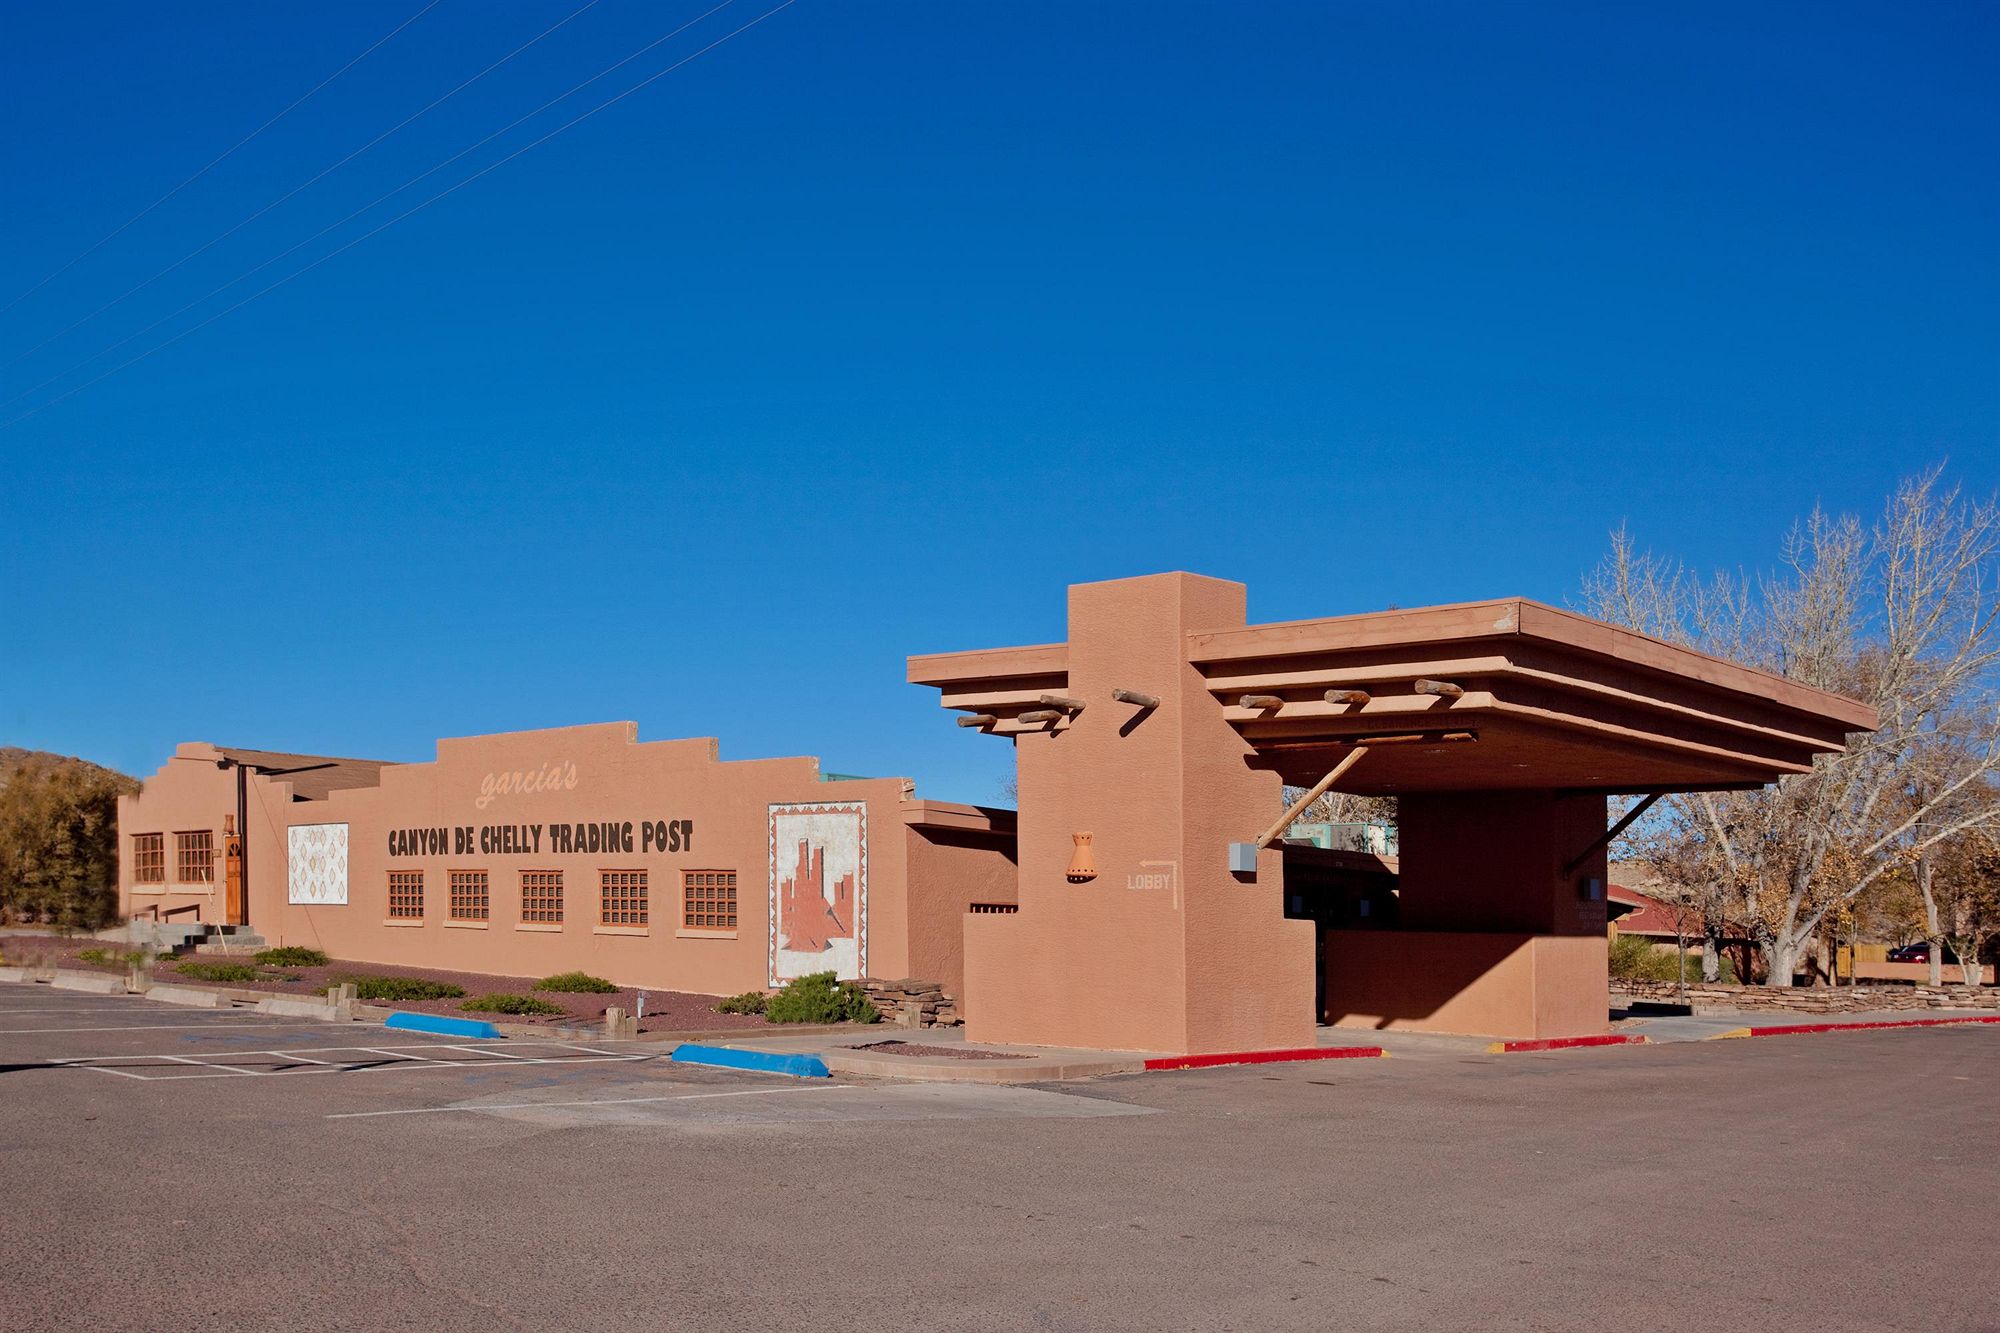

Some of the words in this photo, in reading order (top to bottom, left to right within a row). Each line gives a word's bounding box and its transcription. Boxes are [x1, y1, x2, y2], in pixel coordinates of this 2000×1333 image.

[388, 827, 449, 857] CANYON
[454, 826, 475, 855] DE
[480, 824, 542, 854] CHELLY
[549, 821, 633, 853] TRADING
[641, 819, 693, 853] POST
[1127, 874, 1170, 890] LOBBY
